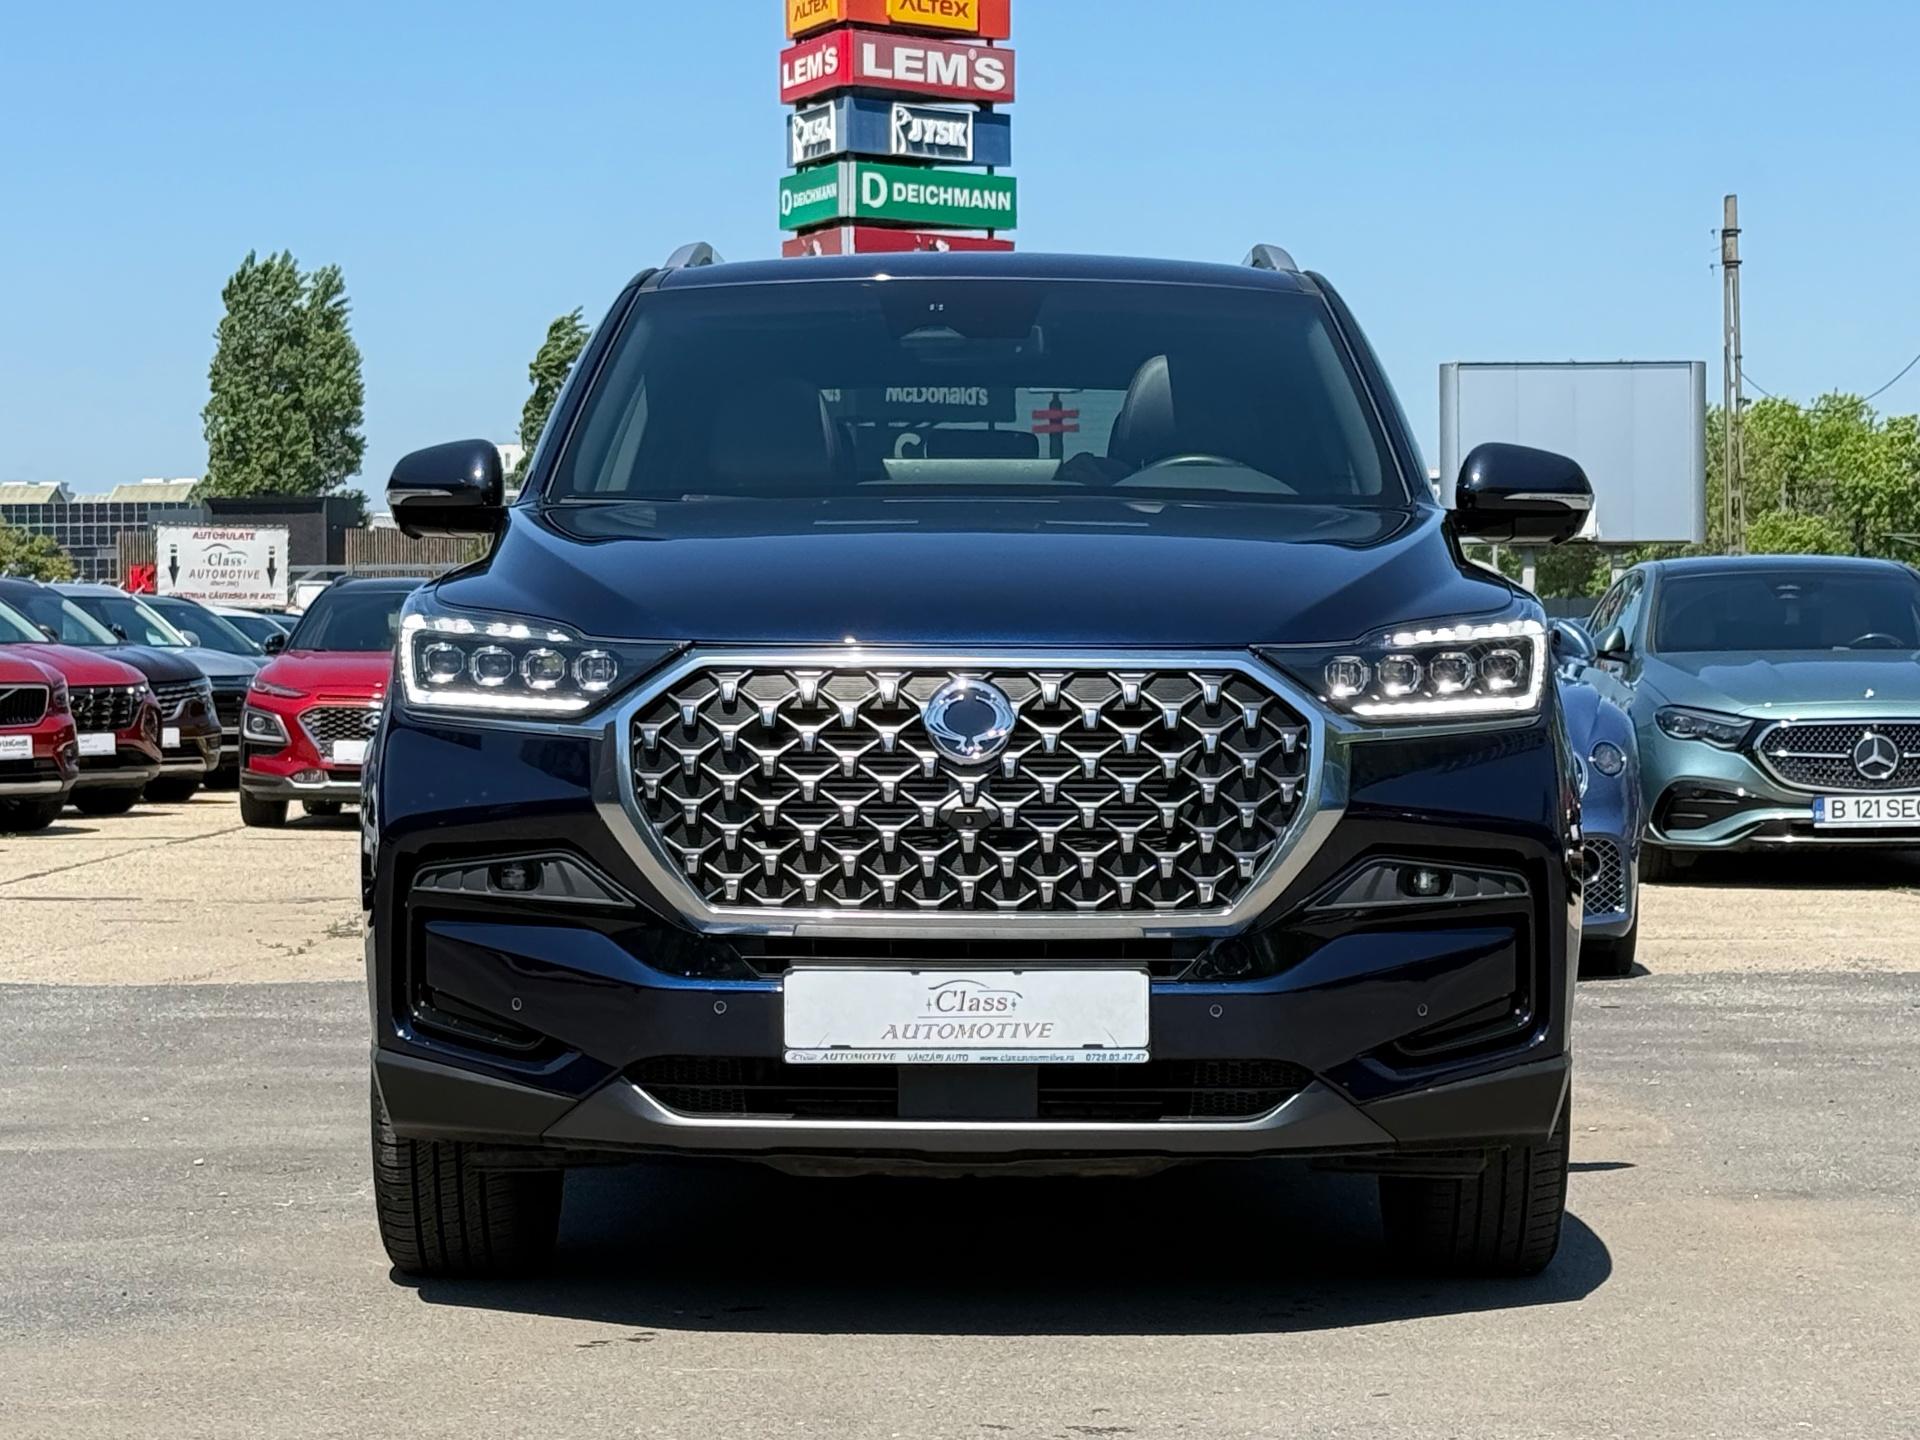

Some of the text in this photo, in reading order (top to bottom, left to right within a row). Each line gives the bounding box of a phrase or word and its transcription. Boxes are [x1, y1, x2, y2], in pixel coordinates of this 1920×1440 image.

[782, 45, 838, 89] LEM'S
[862, 43, 1006, 91] LEM'S
[908, 117, 968, 147] JYSK
[862, 171, 1011, 211] D DEICHMANN
[192, 531, 256, 541] AUTORULATE
[207, 552, 243, 567] Class
[188, 569, 261, 580] AUTOMOTIVE
[1832, 800, 1846, 818] B
[1854, 800, 1880, 818] 121
[1886, 799, 1920, 818] SE
[935, 991, 1008, 1012] Class
[881, 1023, 1054, 1040] AUTOMOTIVE
[820, 1053, 896, 1061] AUTOMOTIVE
[945, 1053, 969, 1062] AUTO
